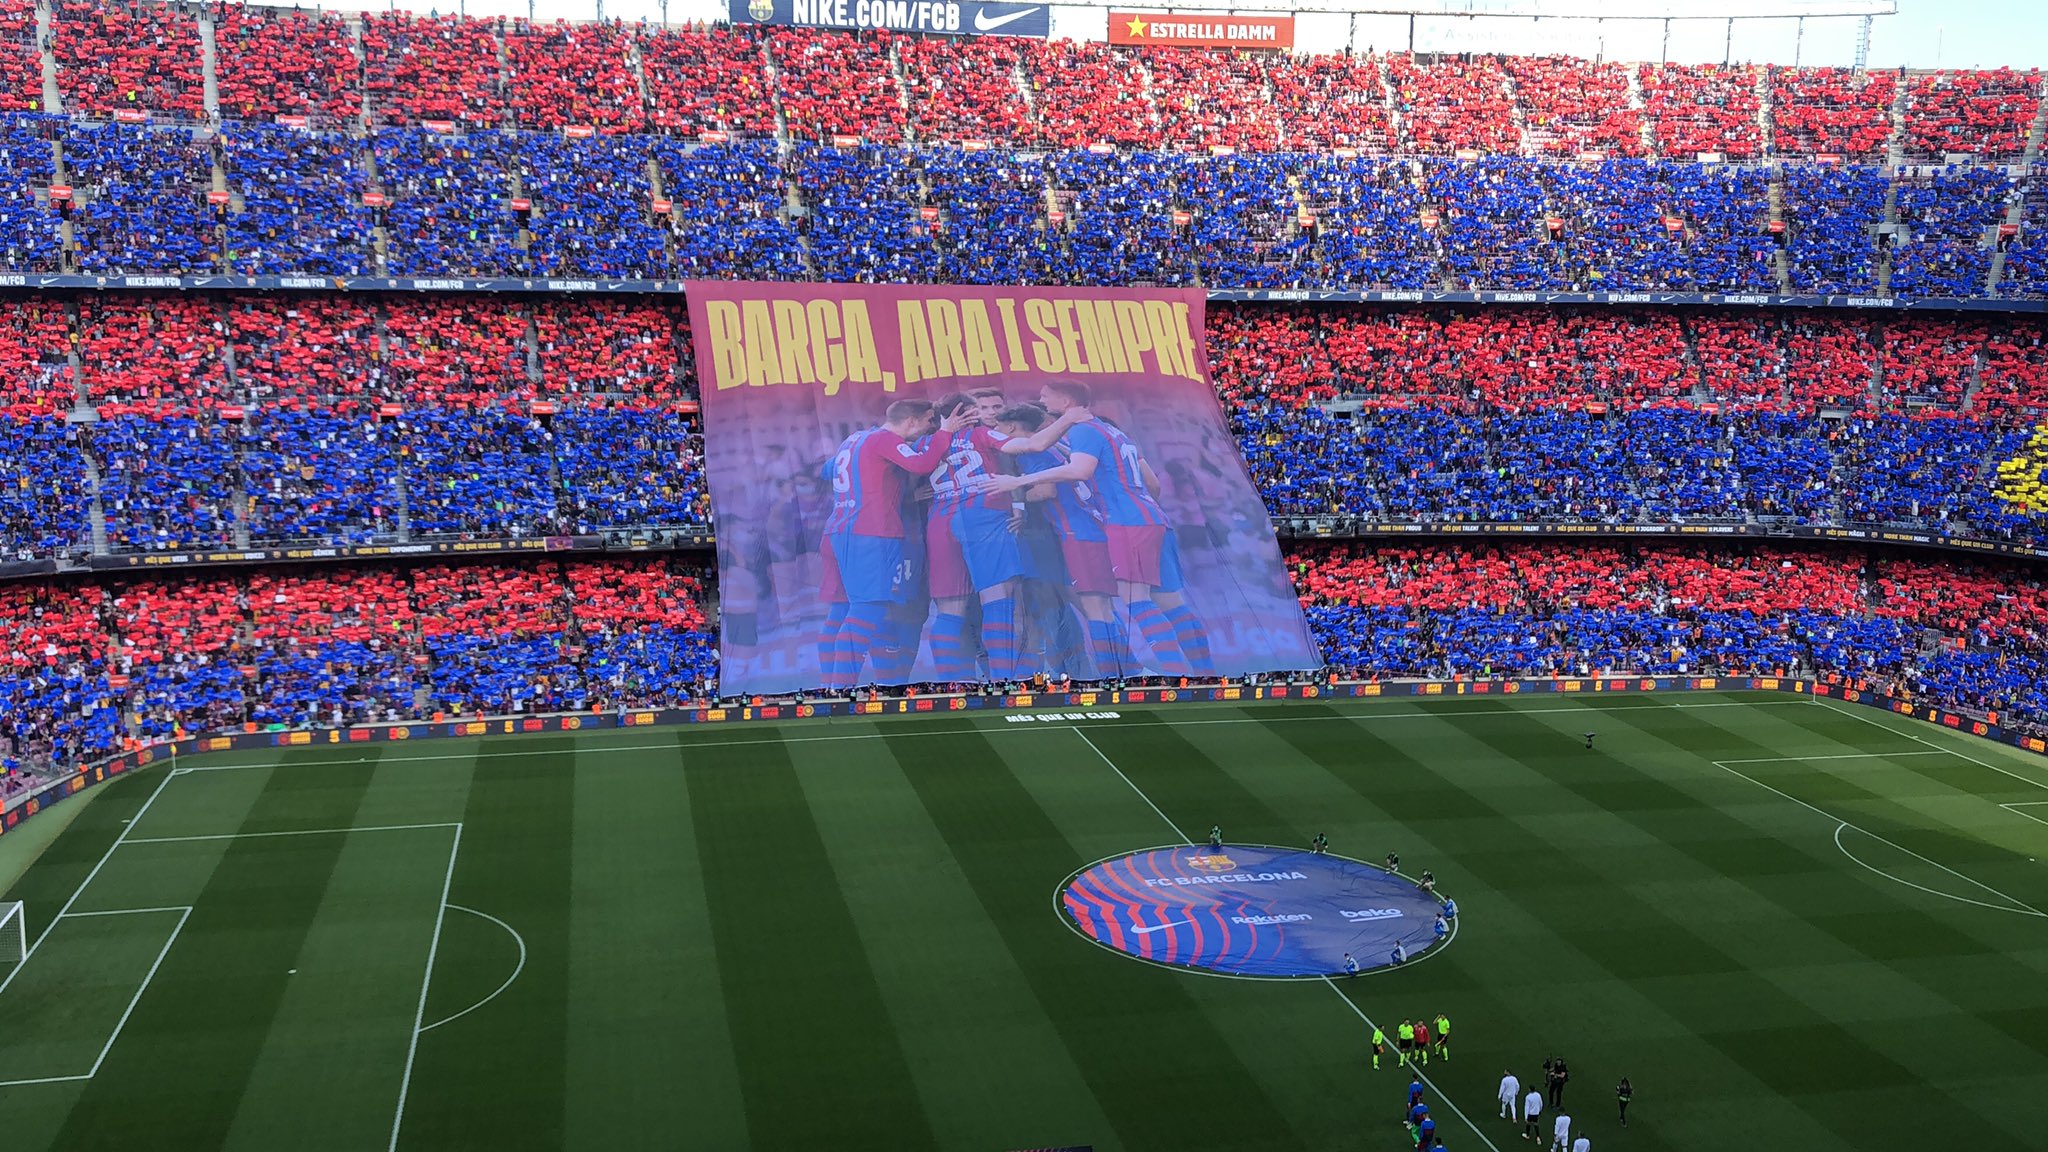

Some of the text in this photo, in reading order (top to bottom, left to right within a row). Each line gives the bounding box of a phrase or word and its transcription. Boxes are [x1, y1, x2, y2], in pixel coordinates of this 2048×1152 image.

[792, 0, 960, 32] NIKE.COM/FCB
[1149, 22, 1276, 42] ESTRELLA DAMM
[705, 297, 1205, 396] BARÇA, ARA I SEMPRE
[1036, 713, 1066, 722] QUE
[1085, 711, 1121, 719] CLUB
[1145, 871, 1308, 888] FC BARCELONA
[1231, 913, 1313, 925] Rakuten
[1339, 908, 1403, 919] beko
